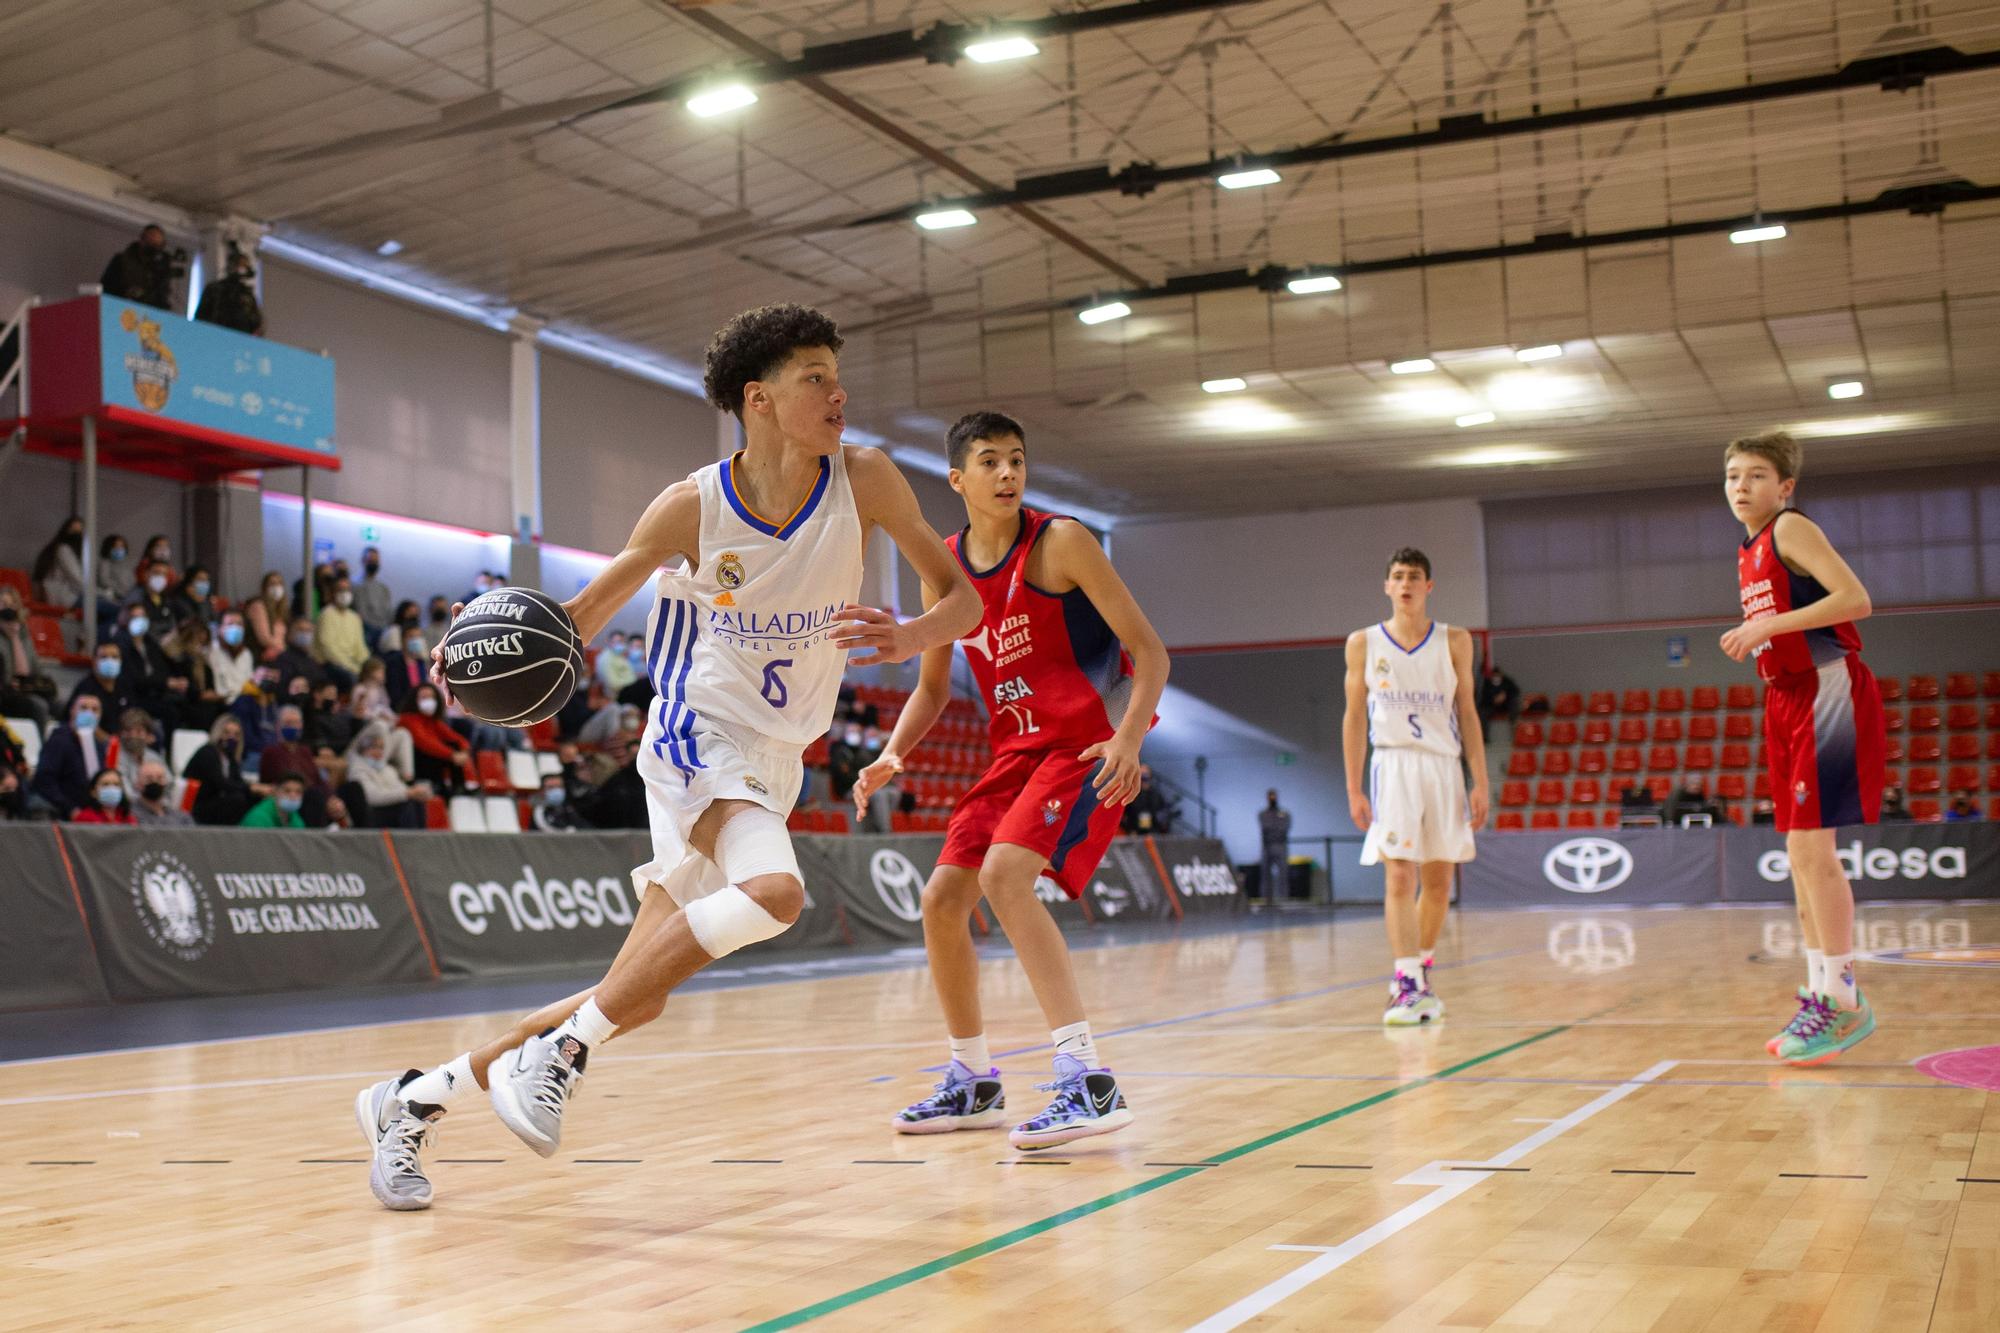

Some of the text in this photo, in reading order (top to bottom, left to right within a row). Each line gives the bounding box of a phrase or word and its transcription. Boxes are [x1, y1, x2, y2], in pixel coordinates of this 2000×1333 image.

[1408, 713, 1422, 739] 5
[1757, 840, 1967, 883] edesa
[214, 872, 367, 899] UNIVERSIDAD
[449, 864, 634, 936] endesa
[227, 902, 380, 934] DE GRANADA
